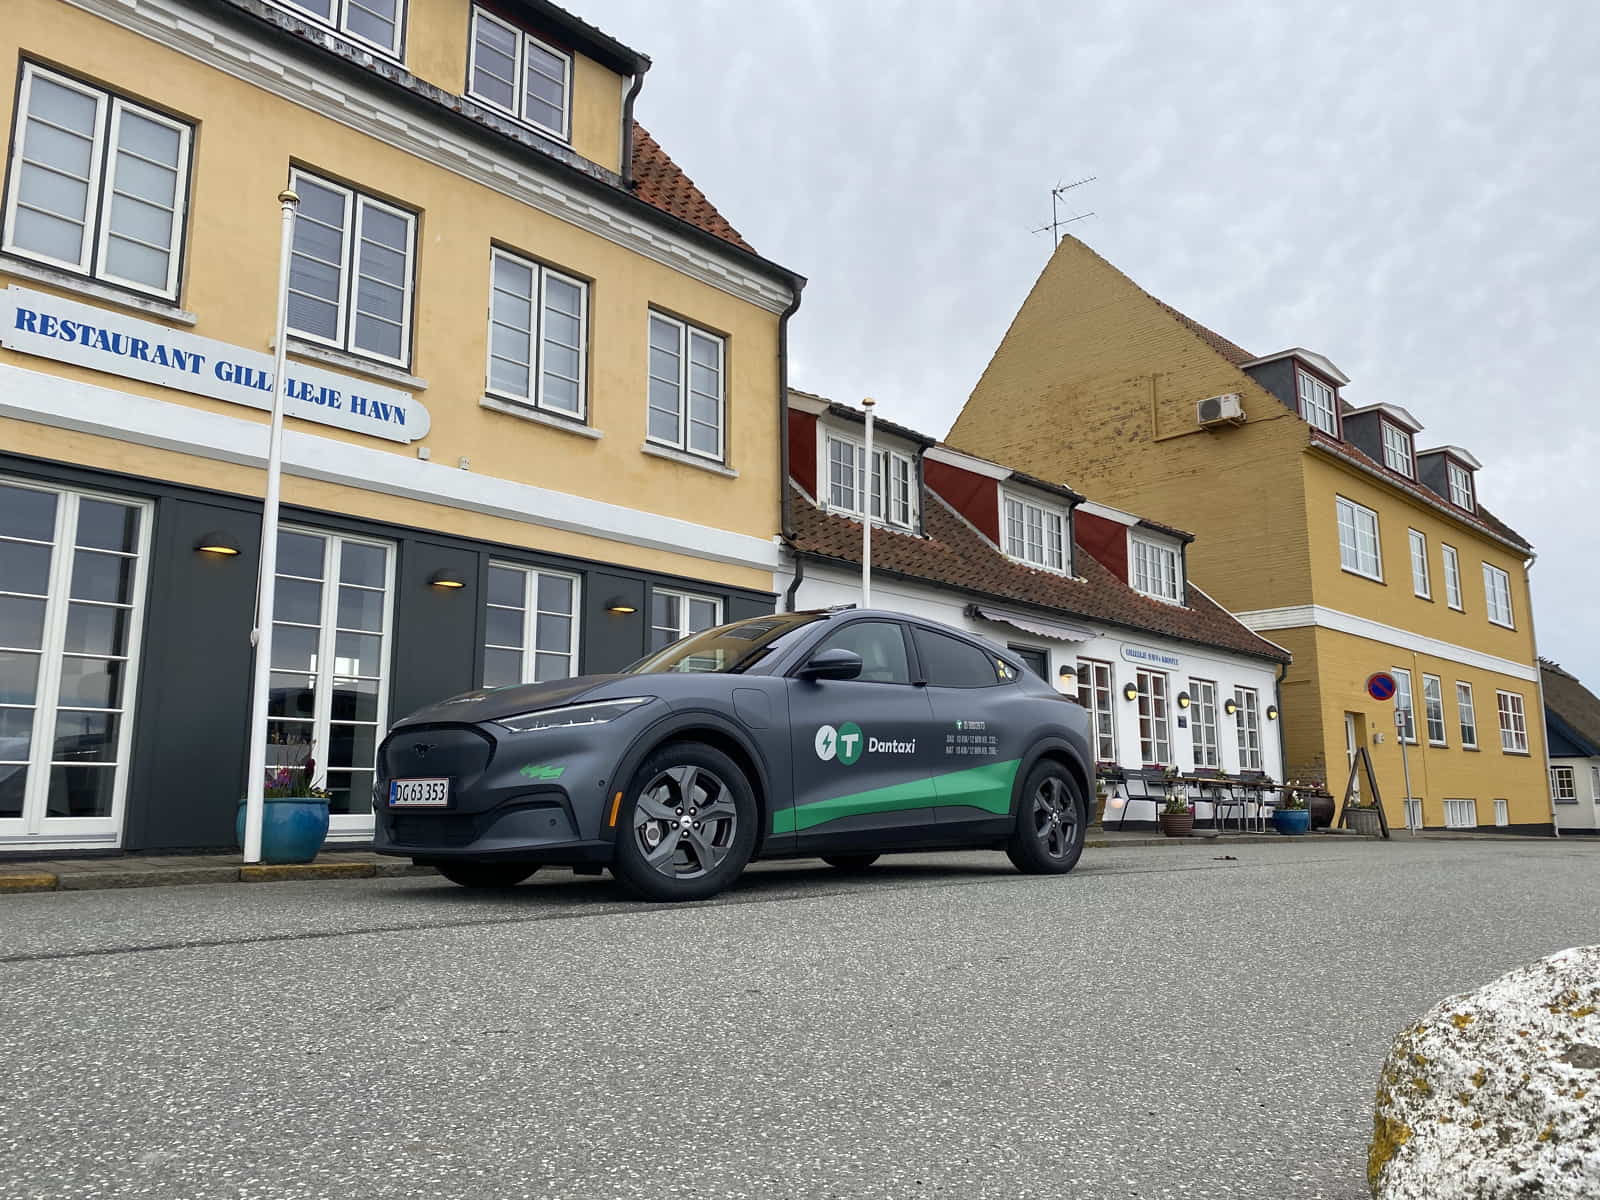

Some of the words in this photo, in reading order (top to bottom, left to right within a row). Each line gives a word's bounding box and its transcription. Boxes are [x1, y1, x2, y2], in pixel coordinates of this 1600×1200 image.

[14, 307, 206, 375] RESTAURANT
[214, 360, 342, 410] GILLLEJE
[350, 395, 407, 426] HAVN
[868, 737, 916, 754] Dantaxi
